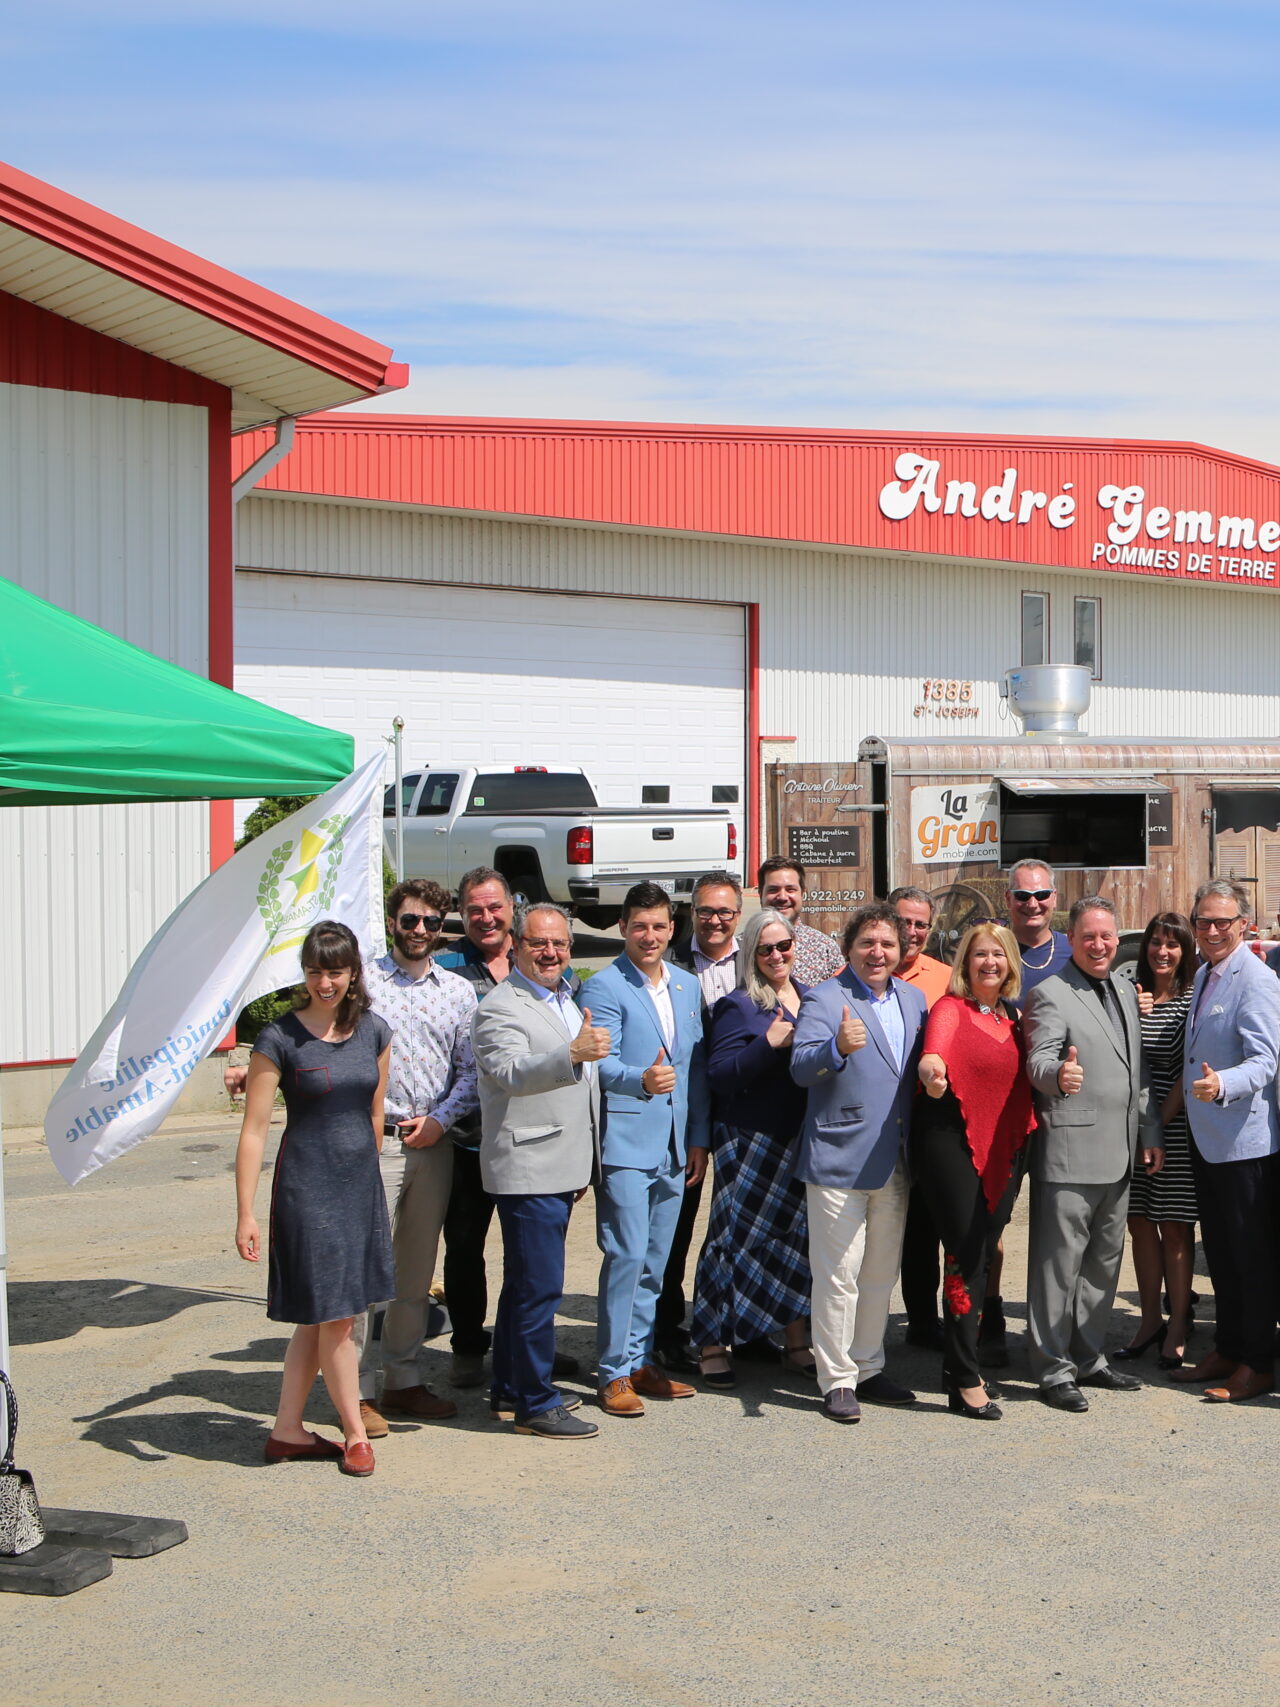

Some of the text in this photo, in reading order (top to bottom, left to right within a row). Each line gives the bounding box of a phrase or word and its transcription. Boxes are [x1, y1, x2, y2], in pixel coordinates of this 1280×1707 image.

[879, 453, 1075, 529] André
[1098, 484, 1280, 552] Gemme
[1092, 543, 1276, 580] POMMES DE TERRE
[923, 680, 973, 701] 1385
[784, 778, 864, 794] Antoine Olivier
[940, 789, 968, 821] La
[814, 828, 820, 836] à
[821, 829, 850, 838] poutine
[917, 815, 999, 858] Gran
[829, 849, 834, 857] à
[942, 847, 998, 859] mobile.com
[803, 890, 865, 901] .922.1249
